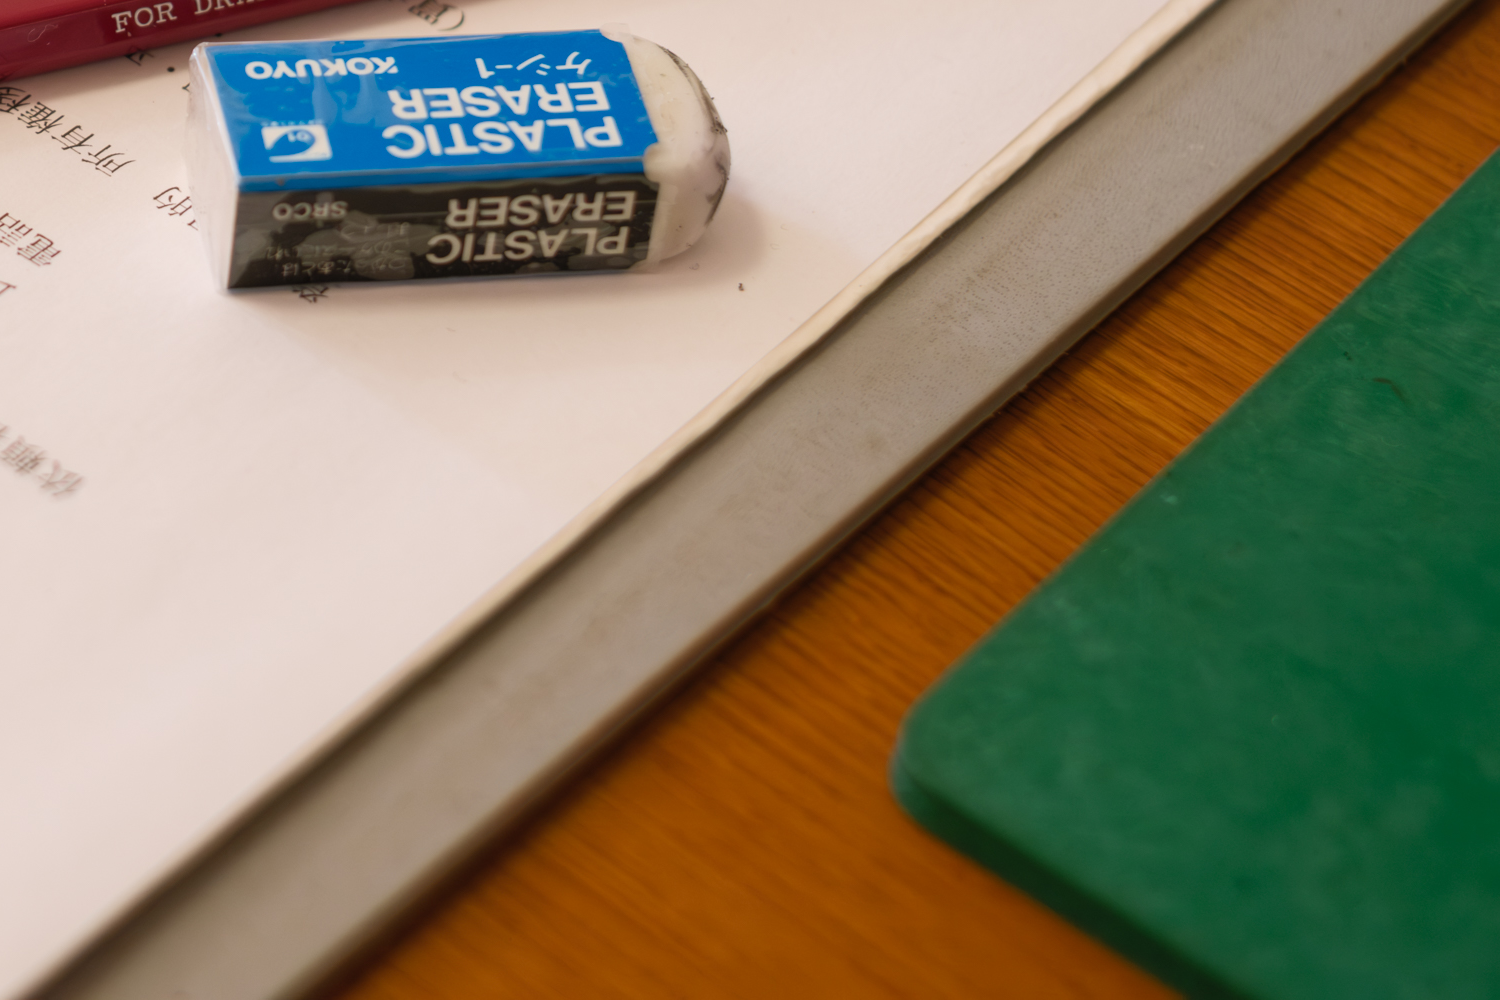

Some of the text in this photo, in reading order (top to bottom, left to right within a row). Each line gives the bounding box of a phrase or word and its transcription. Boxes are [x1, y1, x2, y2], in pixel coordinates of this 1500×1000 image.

[112, 2, 177, 34] FOR
[245, 56, 398, 80] KOKUYO
[388, 81, 611, 119] ERASER
[382, 116, 623, 158] PLASTIC
[446, 191, 637, 229] ERASER
[426, 227, 629, 265] PLASTIC
